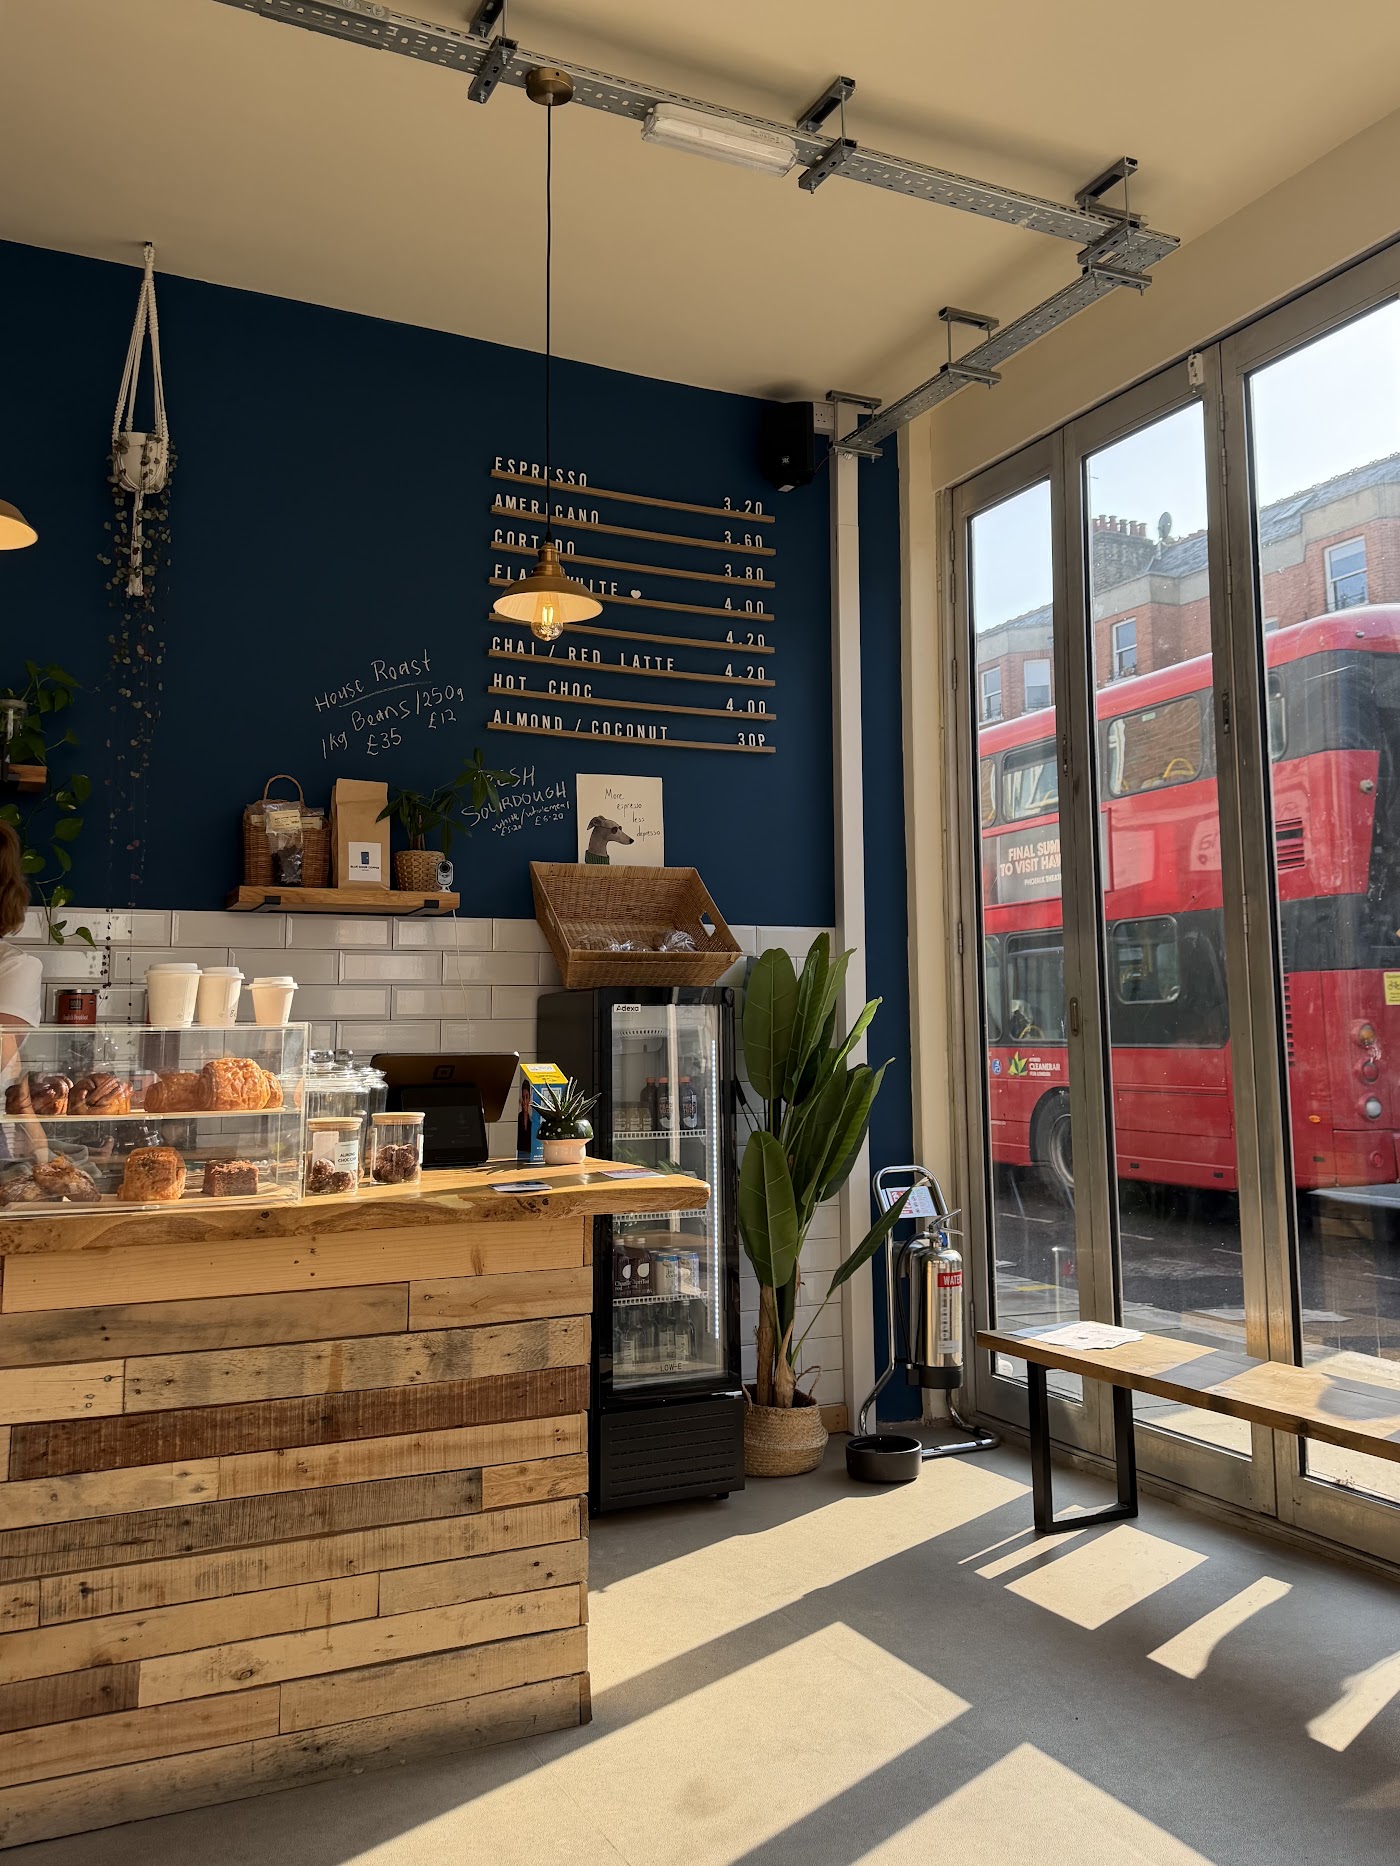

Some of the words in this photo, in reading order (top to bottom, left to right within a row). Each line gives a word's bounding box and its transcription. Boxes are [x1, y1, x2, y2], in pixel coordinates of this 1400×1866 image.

[494, 493, 599, 524] AMERICANO
[724, 497, 763, 515] 3.20
[494, 529, 575, 555] CORTDO
[725, 531, 763, 548] 3.60
[725, 564, 764, 581] 3.80
[725, 598, 764, 614] 4.00
[726, 631, 765, 647] 4.20
[492, 636, 535, 656] CHAI
[548, 645, 556, 658] /
[568, 646, 601, 664] RED
[620, 652, 675, 672] LATTE
[370, 649, 431, 682] Roast
[725, 664, 765, 680] 4.20
[493, 672, 527, 691] HOT
[548, 680, 593, 698] CHOC
[726, 698, 766, 714] 4.00
[351, 700, 411, 732] Beans
[493, 709, 563, 731] ALMOND
[575, 718, 581, 732] /
[591, 720, 668, 740] COCONUT
[366, 727, 402, 756] £35
[738, 733, 766, 747] 30P
[604, 788, 625, 800] More
[636, 825, 661, 842] depresso
[1008, 844, 1035, 862] FINAL
[1000, 863, 1013, 877] TO
[1015, 857, 1039, 874] VISIT
[660, 1362, 682, 1372] LOW-E
